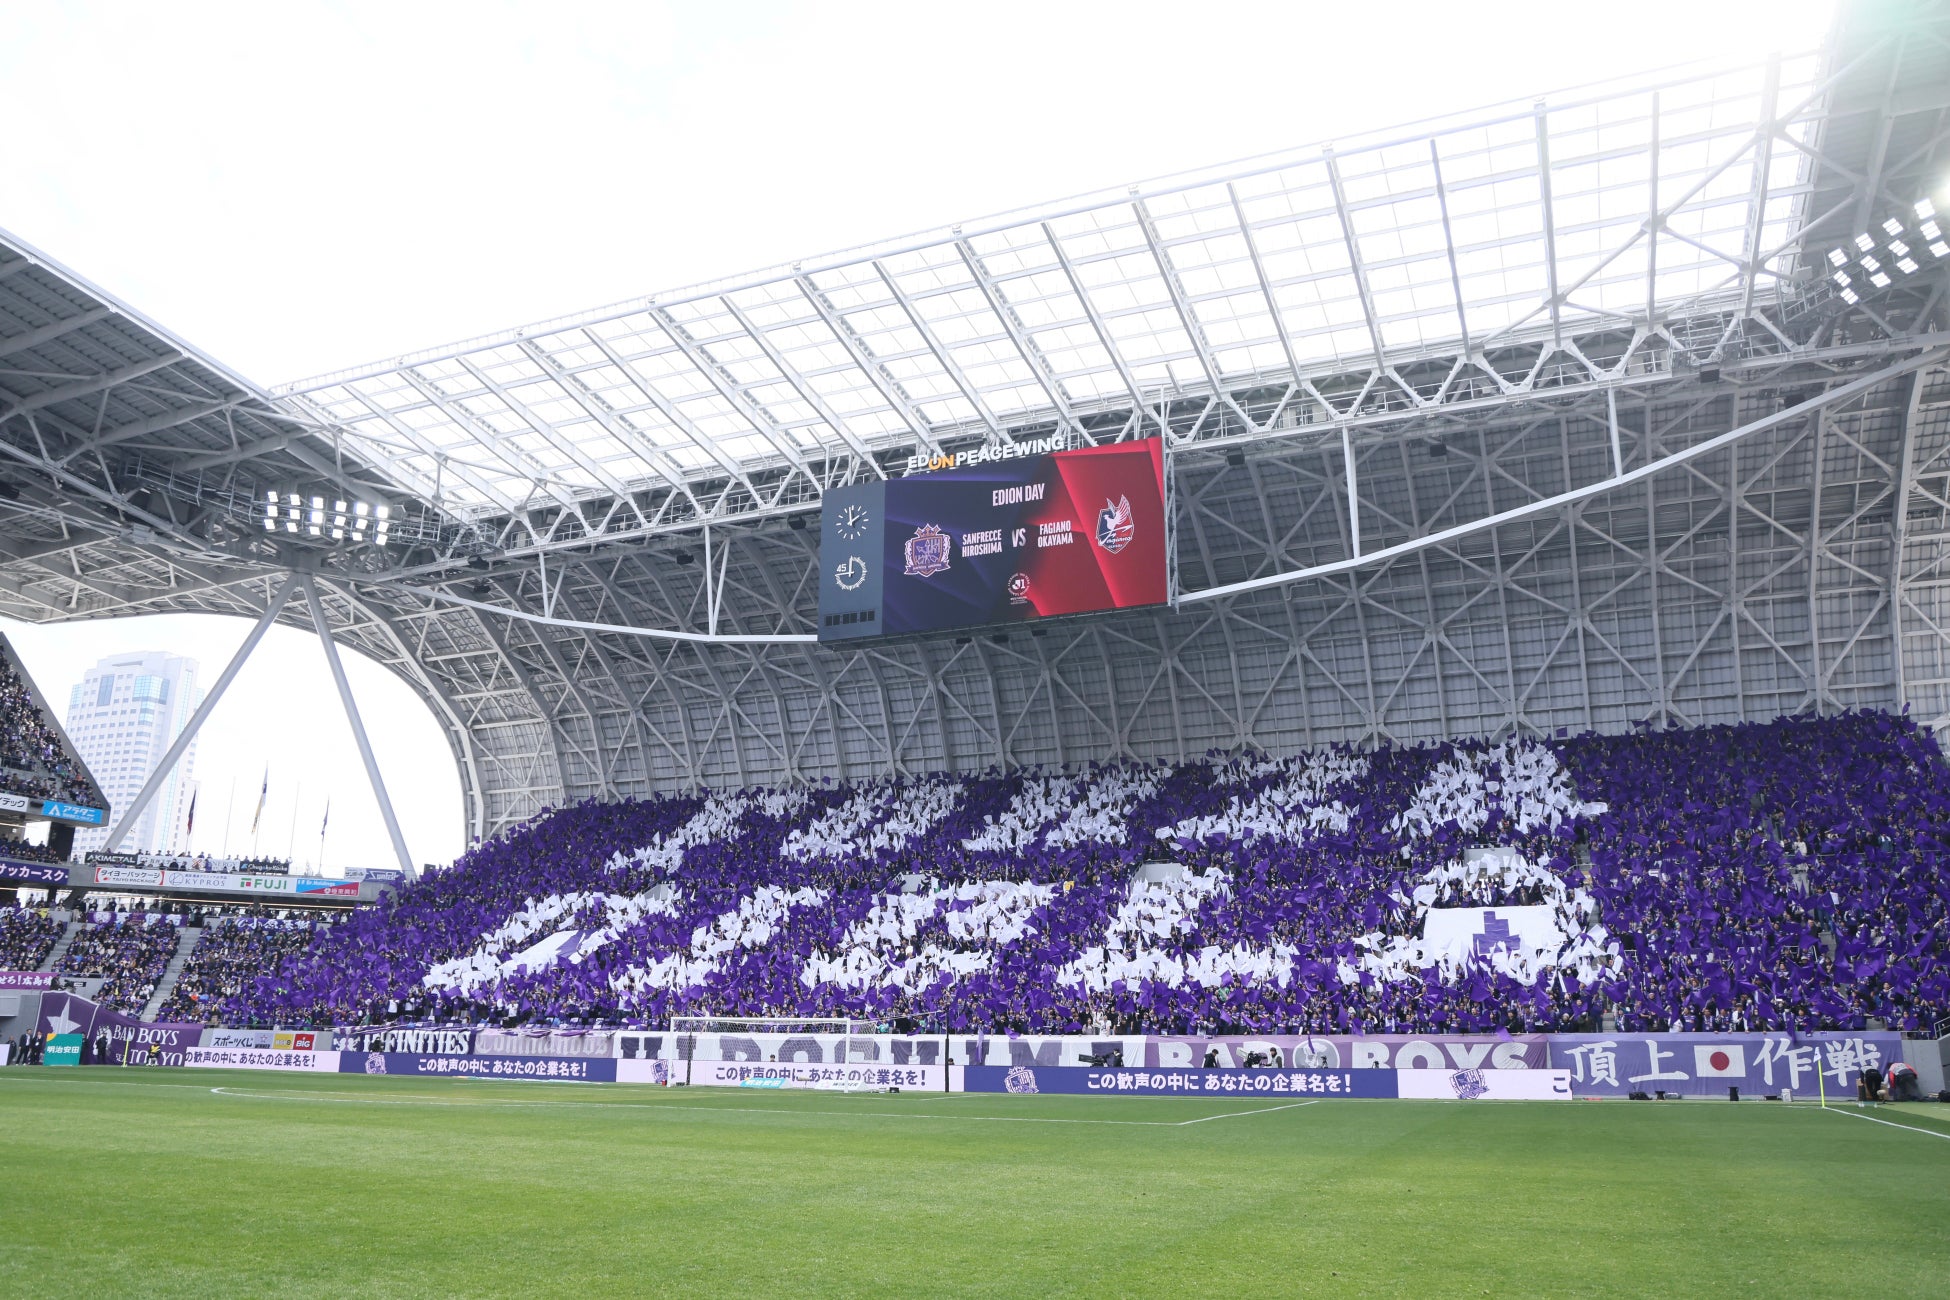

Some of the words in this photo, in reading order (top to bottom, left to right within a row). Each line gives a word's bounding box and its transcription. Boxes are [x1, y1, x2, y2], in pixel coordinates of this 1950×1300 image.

[907, 453, 954, 470] EDION
[992, 486, 1023, 507] EDION
[1024, 483, 1045, 502] DAY
[1039, 520, 1071, 536] FAGIANO
[962, 529, 1002, 546] SANFRECCE
[1012, 527, 1027, 548] VS
[1037, 532, 1074, 548] OKAYAMA
[962, 541, 1003, 558] HIROSHIMA
[836, 563, 847, 573] 45
[87, 854, 136, 864] AKIMETAL
[0, 863, 69, 881] サッカースク
[101, 869, 160, 879] タイヨーパッケージ
[185, 878, 226, 888] KYPROS
[254, 879, 287, 890] FUJI
[112, 1023, 135, 1042] BAD
[136, 1027, 180, 1046] BOYS
[213, 1035, 254, 1048] スポーツくじ
[46, 1045, 80, 1054] 明治安田
[1351, 1040, 1529, 1069] BOYS
[239, 1053, 317, 1068] あなたの企業名を!
[418, 1057, 490, 1073] この歓声の中に
[492, 1060, 588, 1078] あなたの企業名を!
[1563, 1039, 1690, 1088] 頂上
[1752, 1037, 1882, 1090] 作戦
[715, 1065, 803, 1082] この歓声の中に
[808, 1068, 927, 1087] あなたの企業名を!
[1087, 1072, 1199, 1091] この歓声の中に
[1204, 1073, 1352, 1093] あなたの企業名を!
